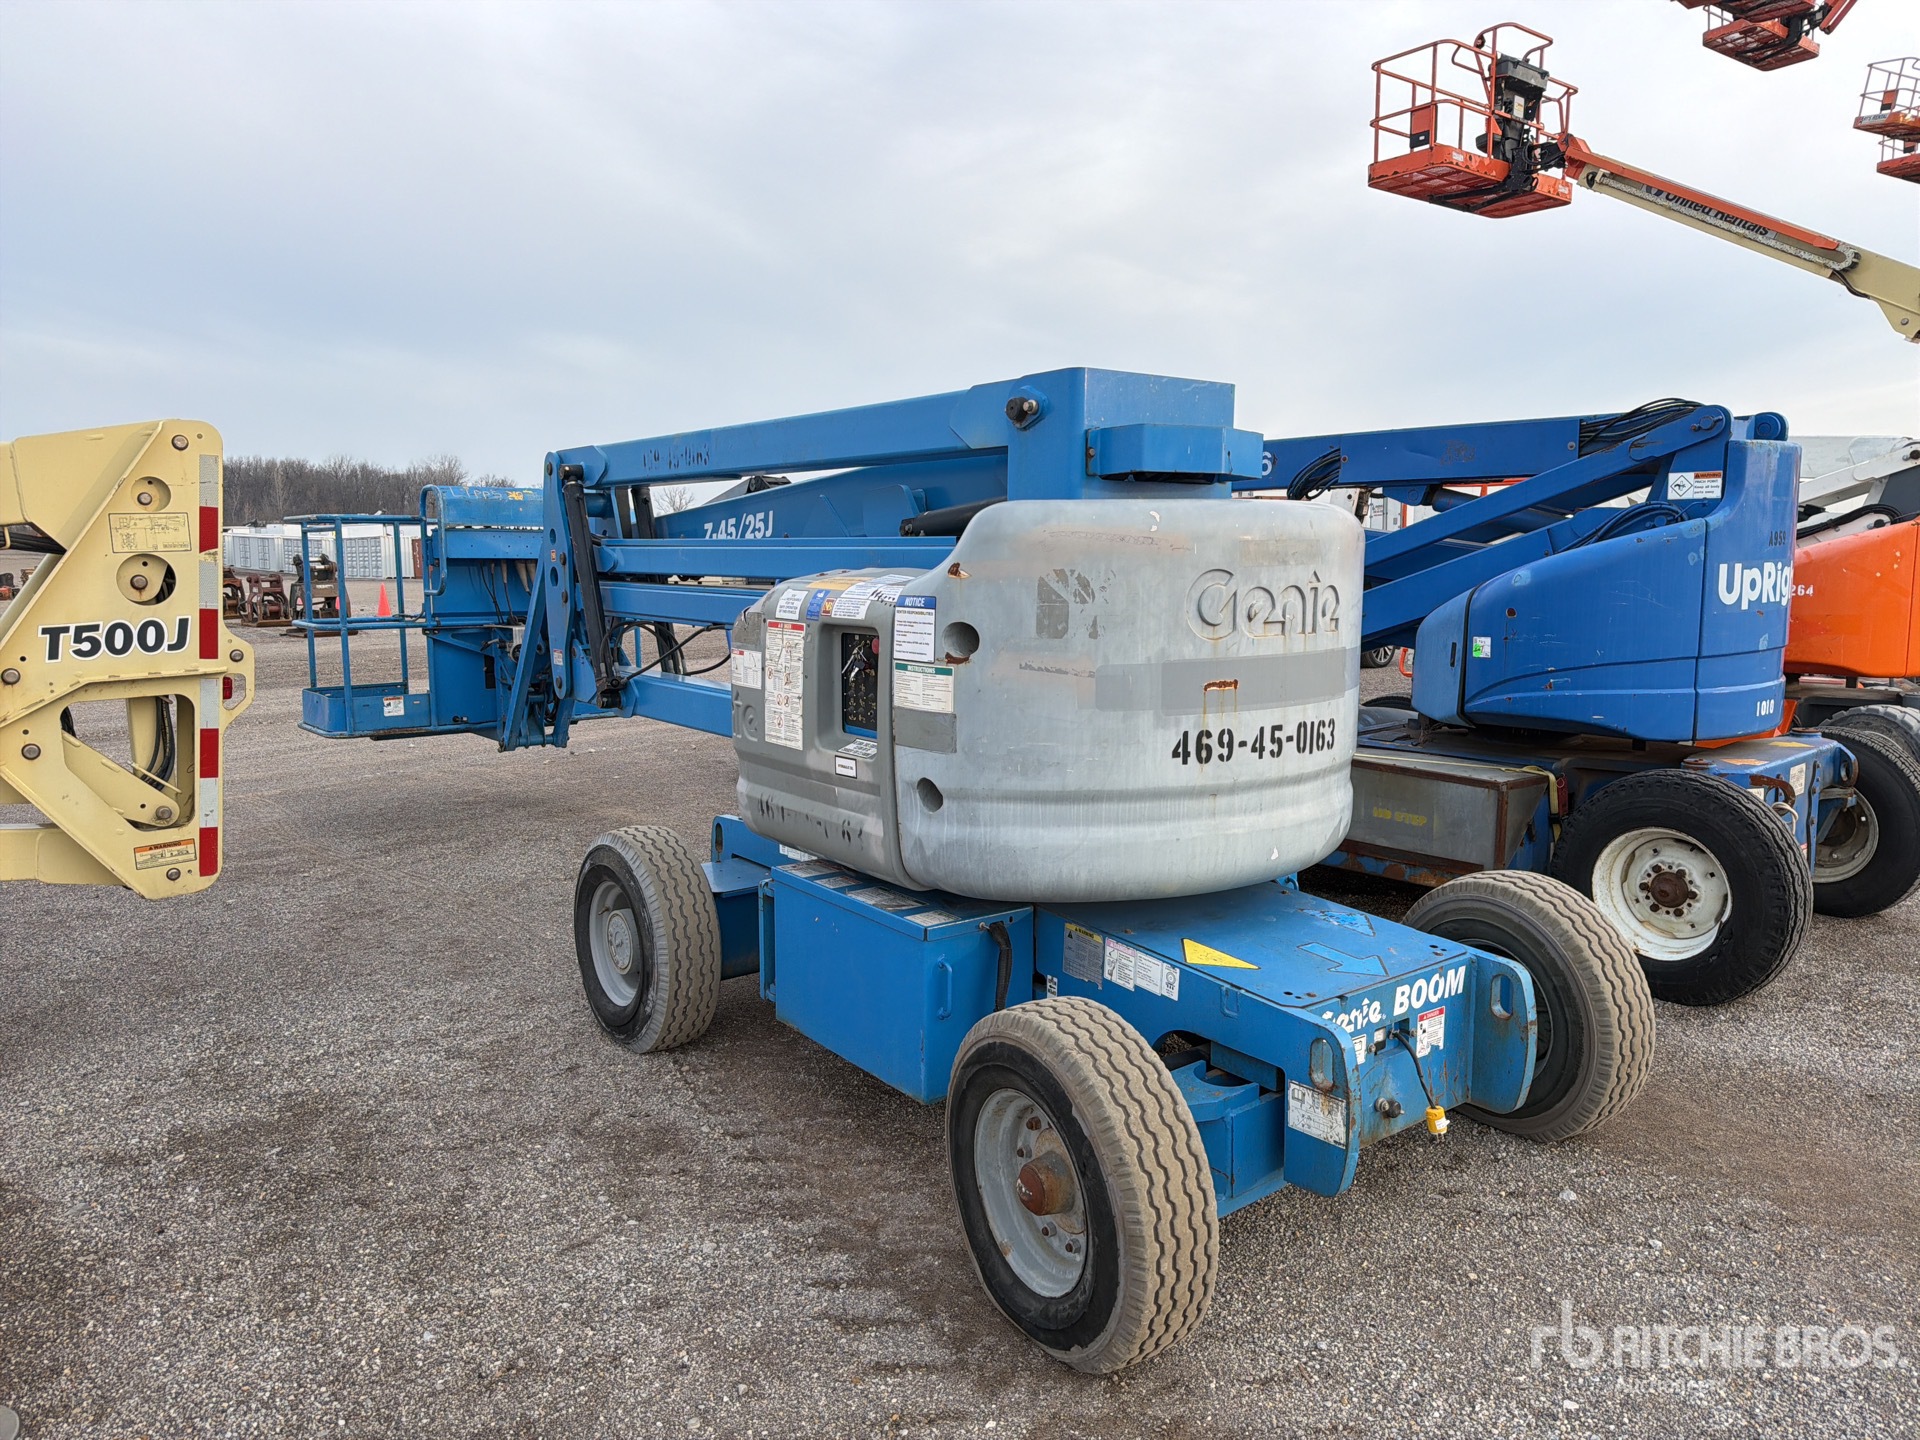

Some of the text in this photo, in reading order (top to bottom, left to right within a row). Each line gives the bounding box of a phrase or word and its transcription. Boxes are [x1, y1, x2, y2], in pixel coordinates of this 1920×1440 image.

[1665, 192, 1769, 236] United Rentals
[704, 510, 774, 540] Z-45/25J
[904, 596, 926, 608] NOTICE
[1185, 568, 1341, 641] Genie
[40, 616, 190, 662] T500J
[1172, 717, 1336, 766] 469-45-0163
[1394, 811, 1428, 826] STEP
[153, 841, 182, 851] WARNING
[1393, 965, 1467, 1017] BOOM
